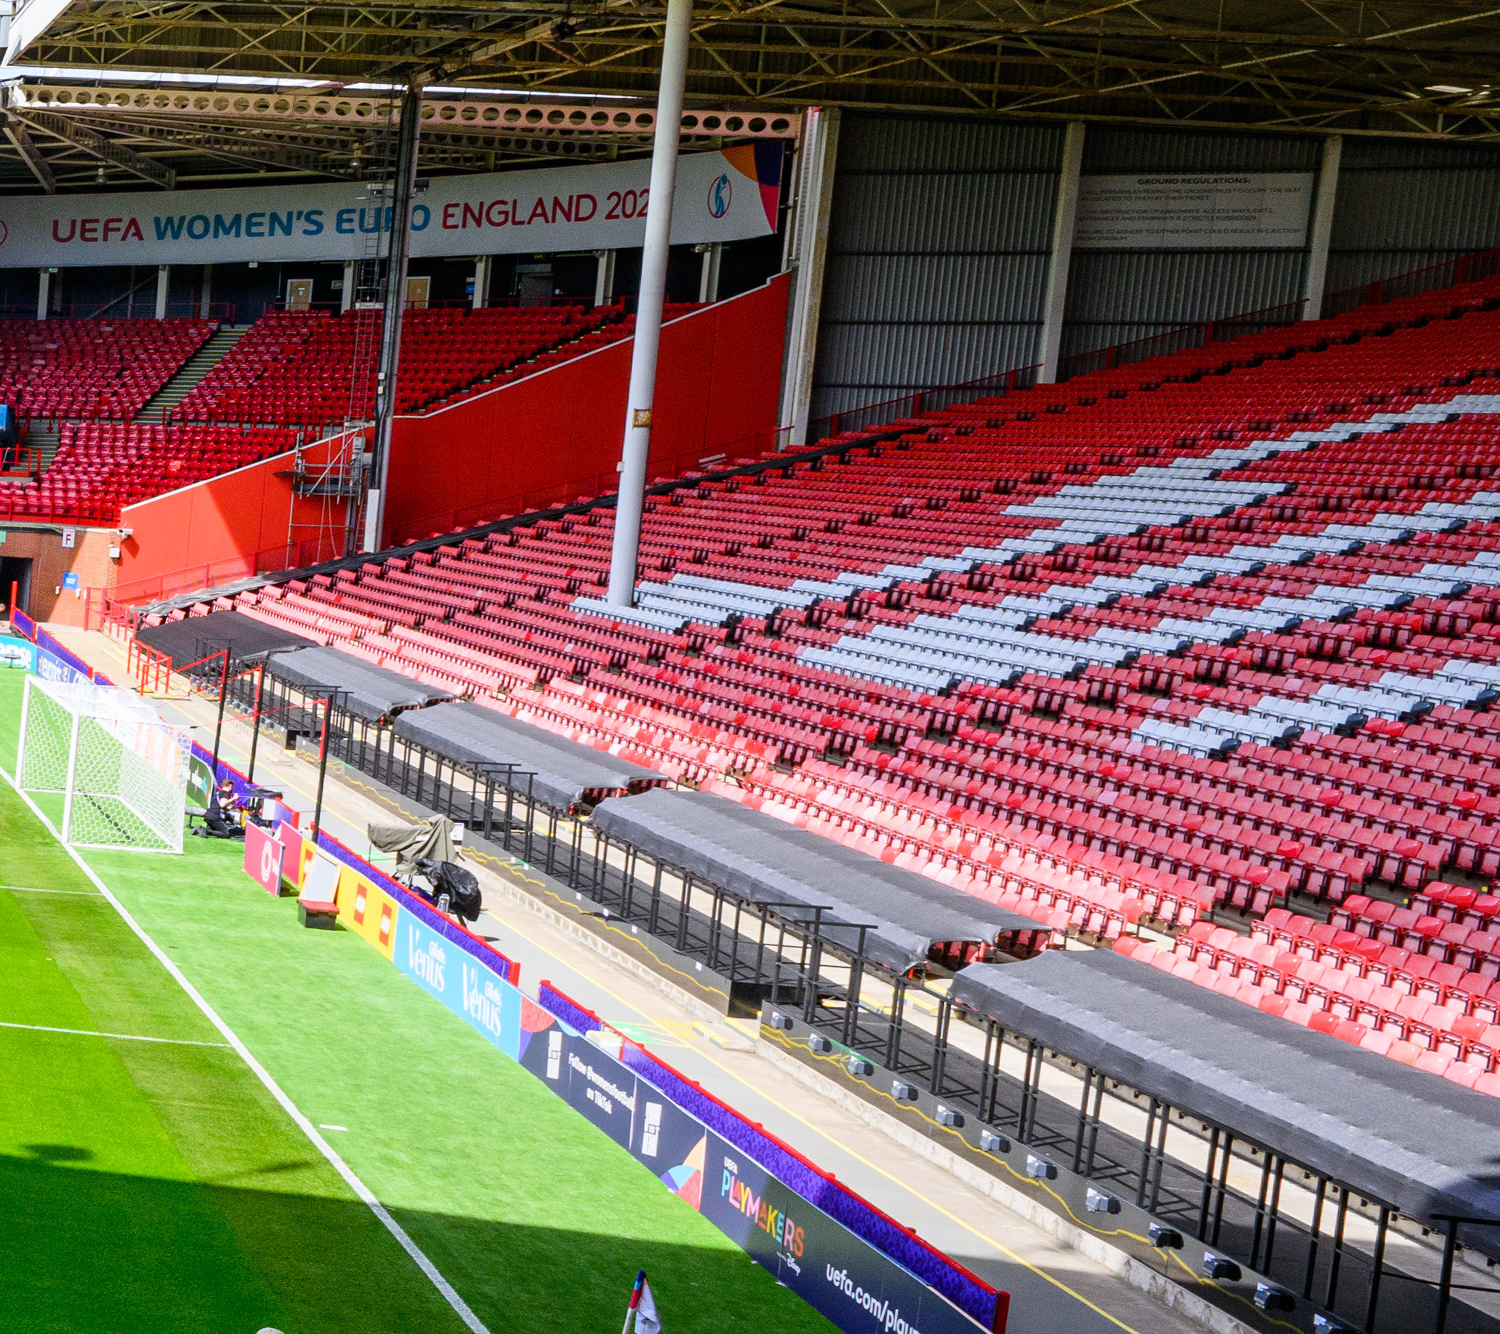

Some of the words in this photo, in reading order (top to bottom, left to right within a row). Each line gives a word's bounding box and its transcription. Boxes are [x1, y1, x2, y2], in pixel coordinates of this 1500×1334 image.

[52, 217, 145, 243] UEFA
[154, 209, 325, 242] WOMEN'S
[441, 192, 597, 231] ENGLAND
[604, 186, 651, 221] 202
[65, 533, 72, 545] F
[408, 923, 445, 992] Venus
[462, 962, 502, 1036] Venus
[720, 1169, 805, 1258] PLAYMAKERS
